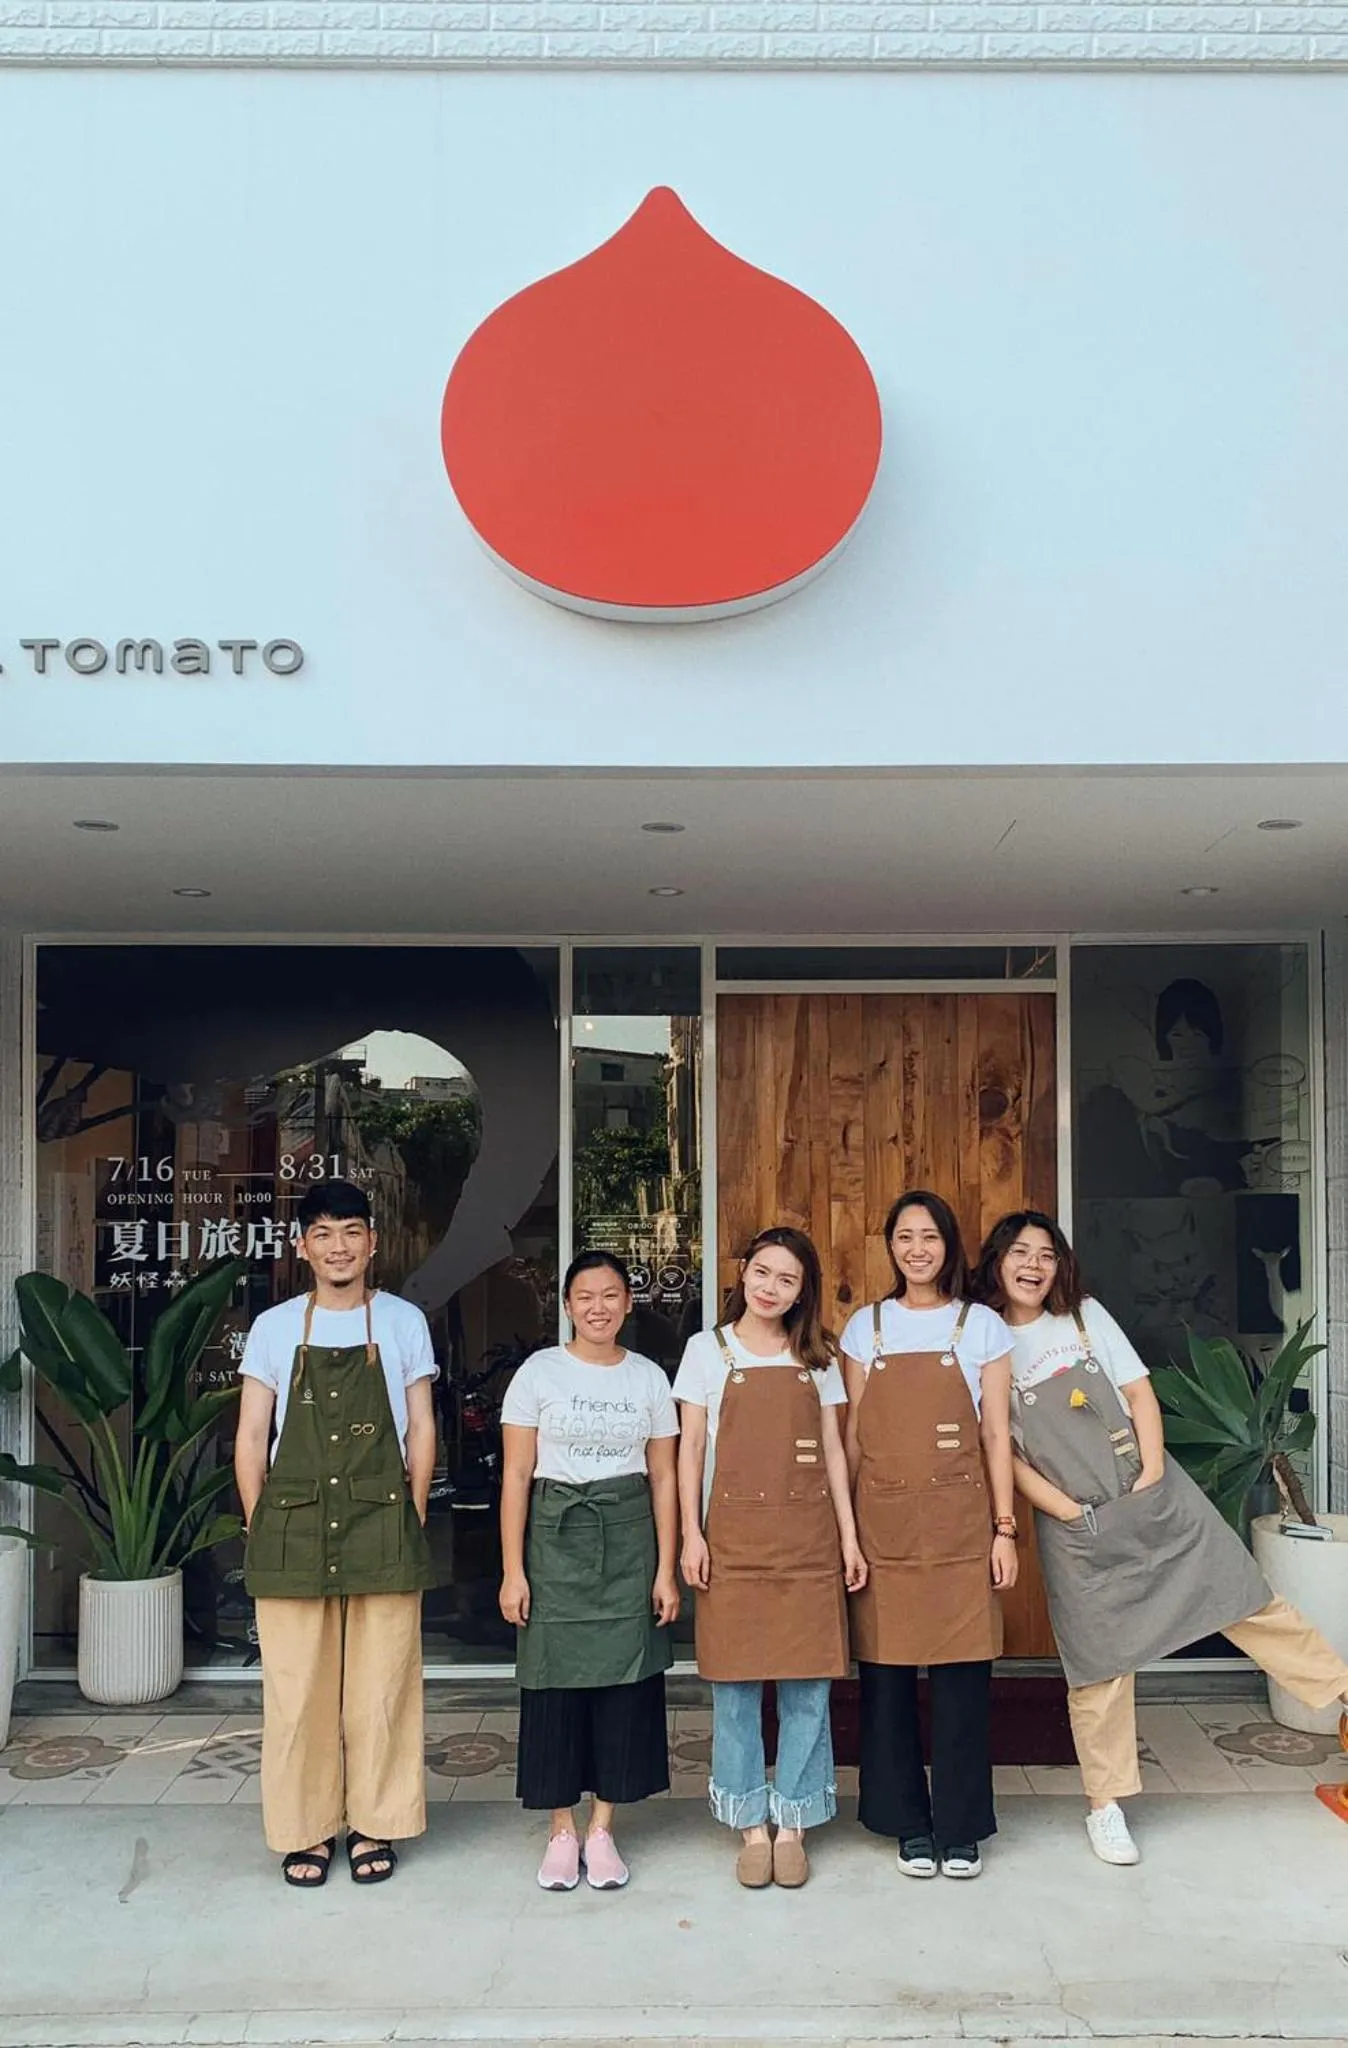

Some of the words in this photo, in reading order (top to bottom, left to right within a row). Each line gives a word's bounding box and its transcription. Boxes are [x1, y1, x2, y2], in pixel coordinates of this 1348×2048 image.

[107, 1156, 174, 1181] 7/16
[182, 1169, 212, 1181] TUE
[279, 1153, 344, 1180] 8/31
[349, 1168, 375, 1179] SAT
[107, 1192, 174, 1205] OPENING
[182, 1192, 223, 1204] HOUR
[237, 1191, 272, 1203] 10:00
[107, 1217, 377, 1261] 夏日旅店
[209, 1370, 235, 1382] SAT
[570, 1394, 638, 1414] friends
